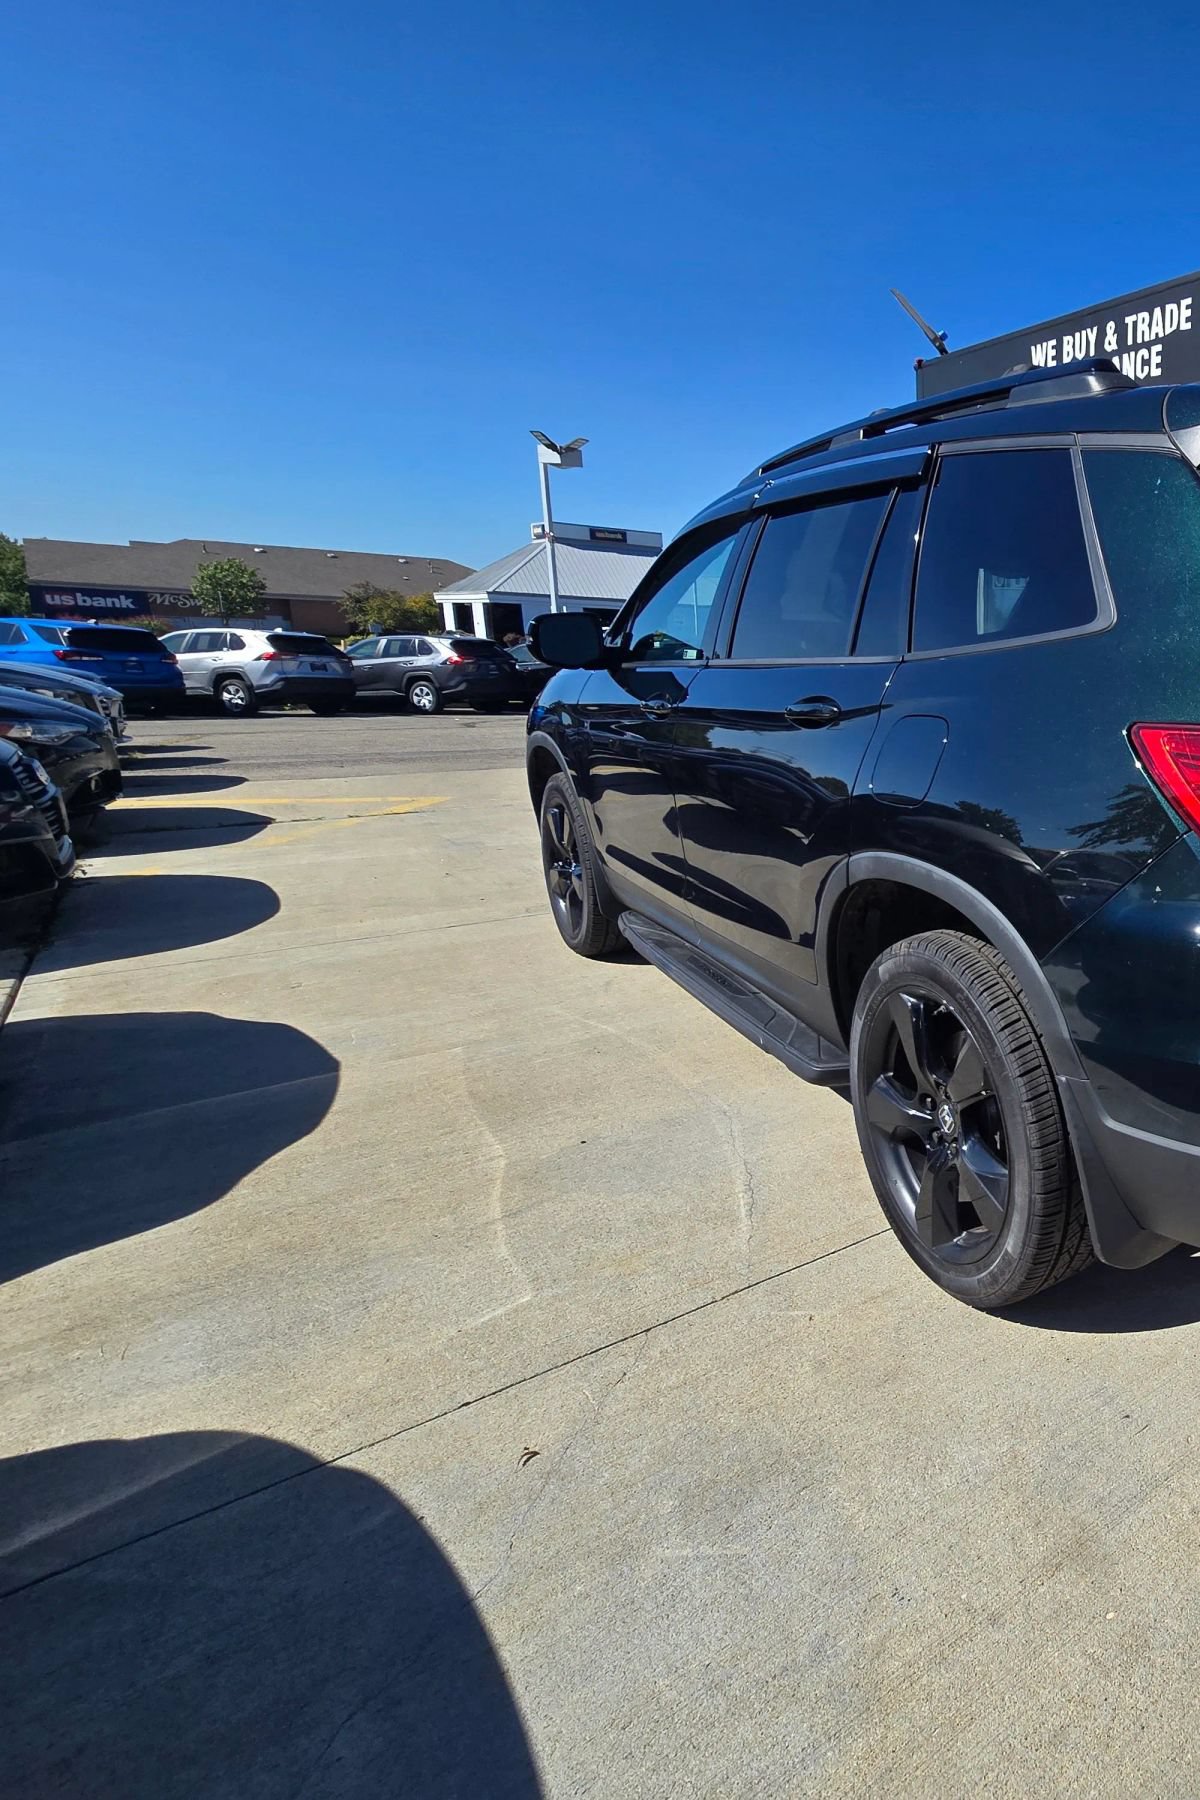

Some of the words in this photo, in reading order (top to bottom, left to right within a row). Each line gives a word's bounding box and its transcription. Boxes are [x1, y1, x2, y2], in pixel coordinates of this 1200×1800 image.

[1031, 339, 1057, 368] WE
[1062, 326, 1098, 364] BUY
[1104, 320, 1119, 353] &
[1125, 297, 1193, 346] TRADE
[1111, 344, 1163, 381] ANCE
[148, 592, 203, 609] McSw
